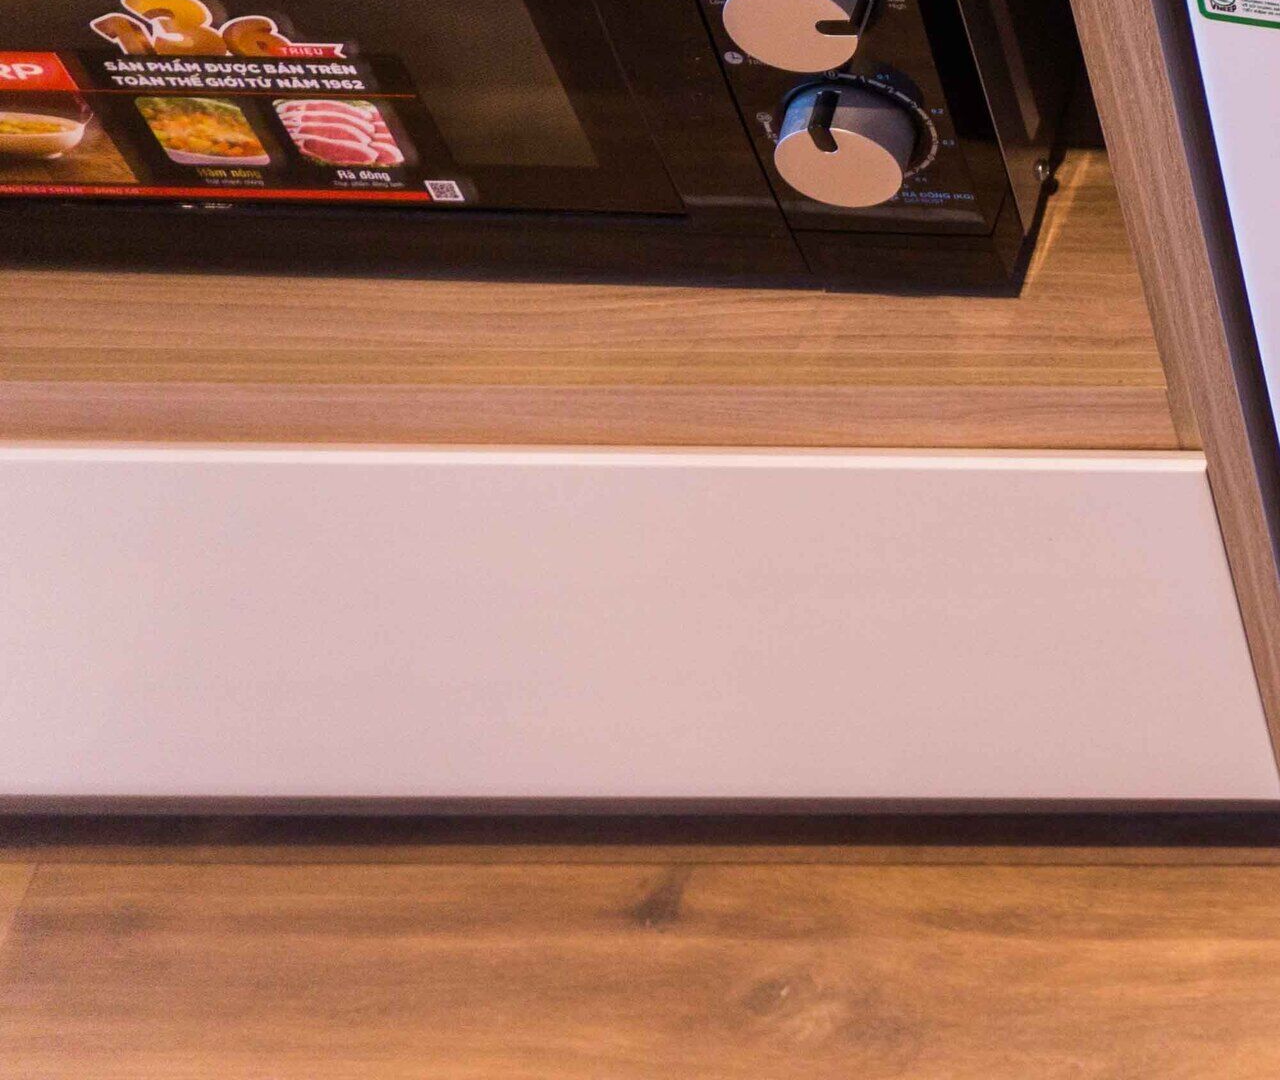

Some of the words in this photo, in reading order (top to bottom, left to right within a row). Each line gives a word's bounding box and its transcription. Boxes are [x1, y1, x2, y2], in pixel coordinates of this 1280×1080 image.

[264, 61, 304, 76] BÁN
[306, 61, 358, 76] TRÊN
[114, 74, 168, 87] TOÀN
[168, 72, 204, 88] THẾ
[205, 75, 243, 88] GIỚI
[276, 76, 322, 90] NĂM
[321, 78, 366, 91] 1962
[359, 170, 391, 182] đông
